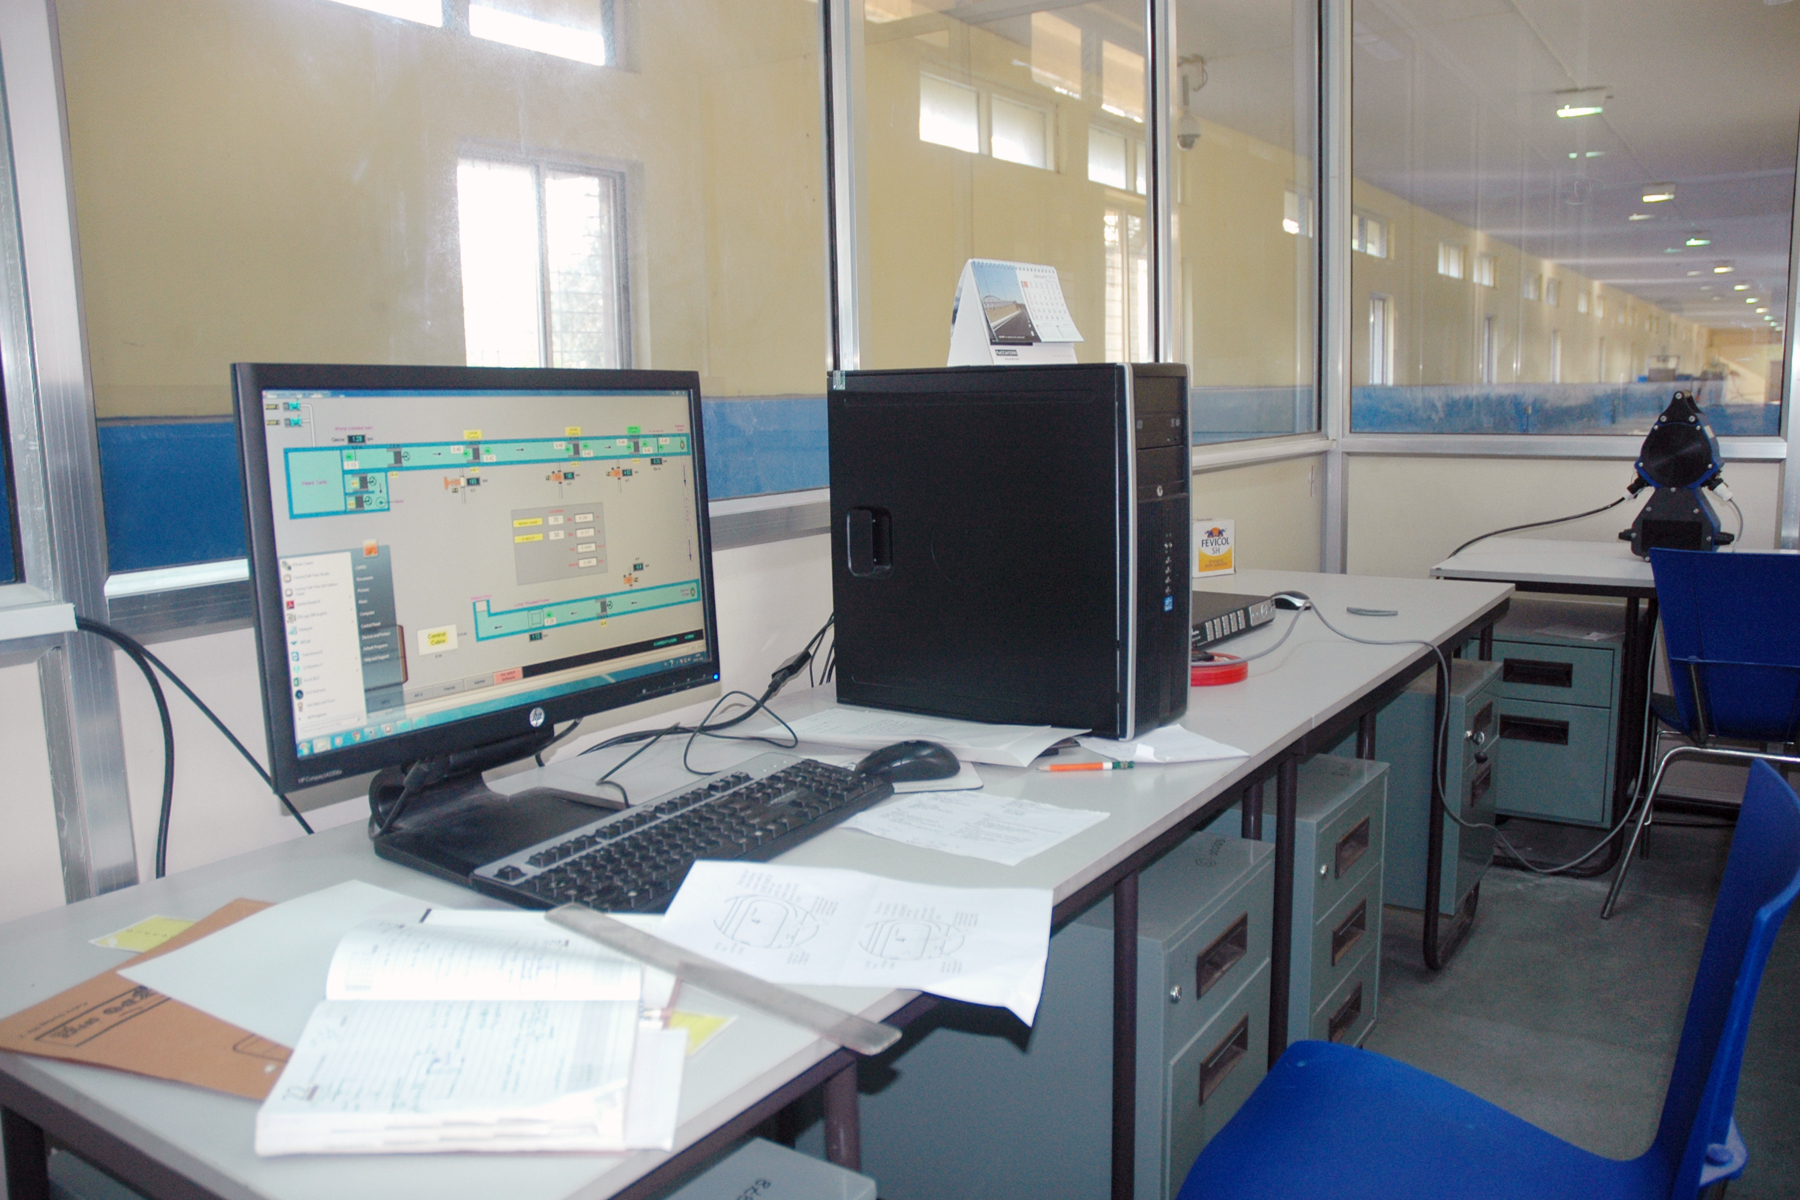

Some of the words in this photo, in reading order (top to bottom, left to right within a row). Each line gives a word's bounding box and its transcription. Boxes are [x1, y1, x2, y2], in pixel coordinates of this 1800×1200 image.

[1201, 537, 1230, 547] FEVICOL
[428, 631, 446, 639] Control
[430, 638, 446, 646] Cabin
[531, 707, 544, 727] hp
